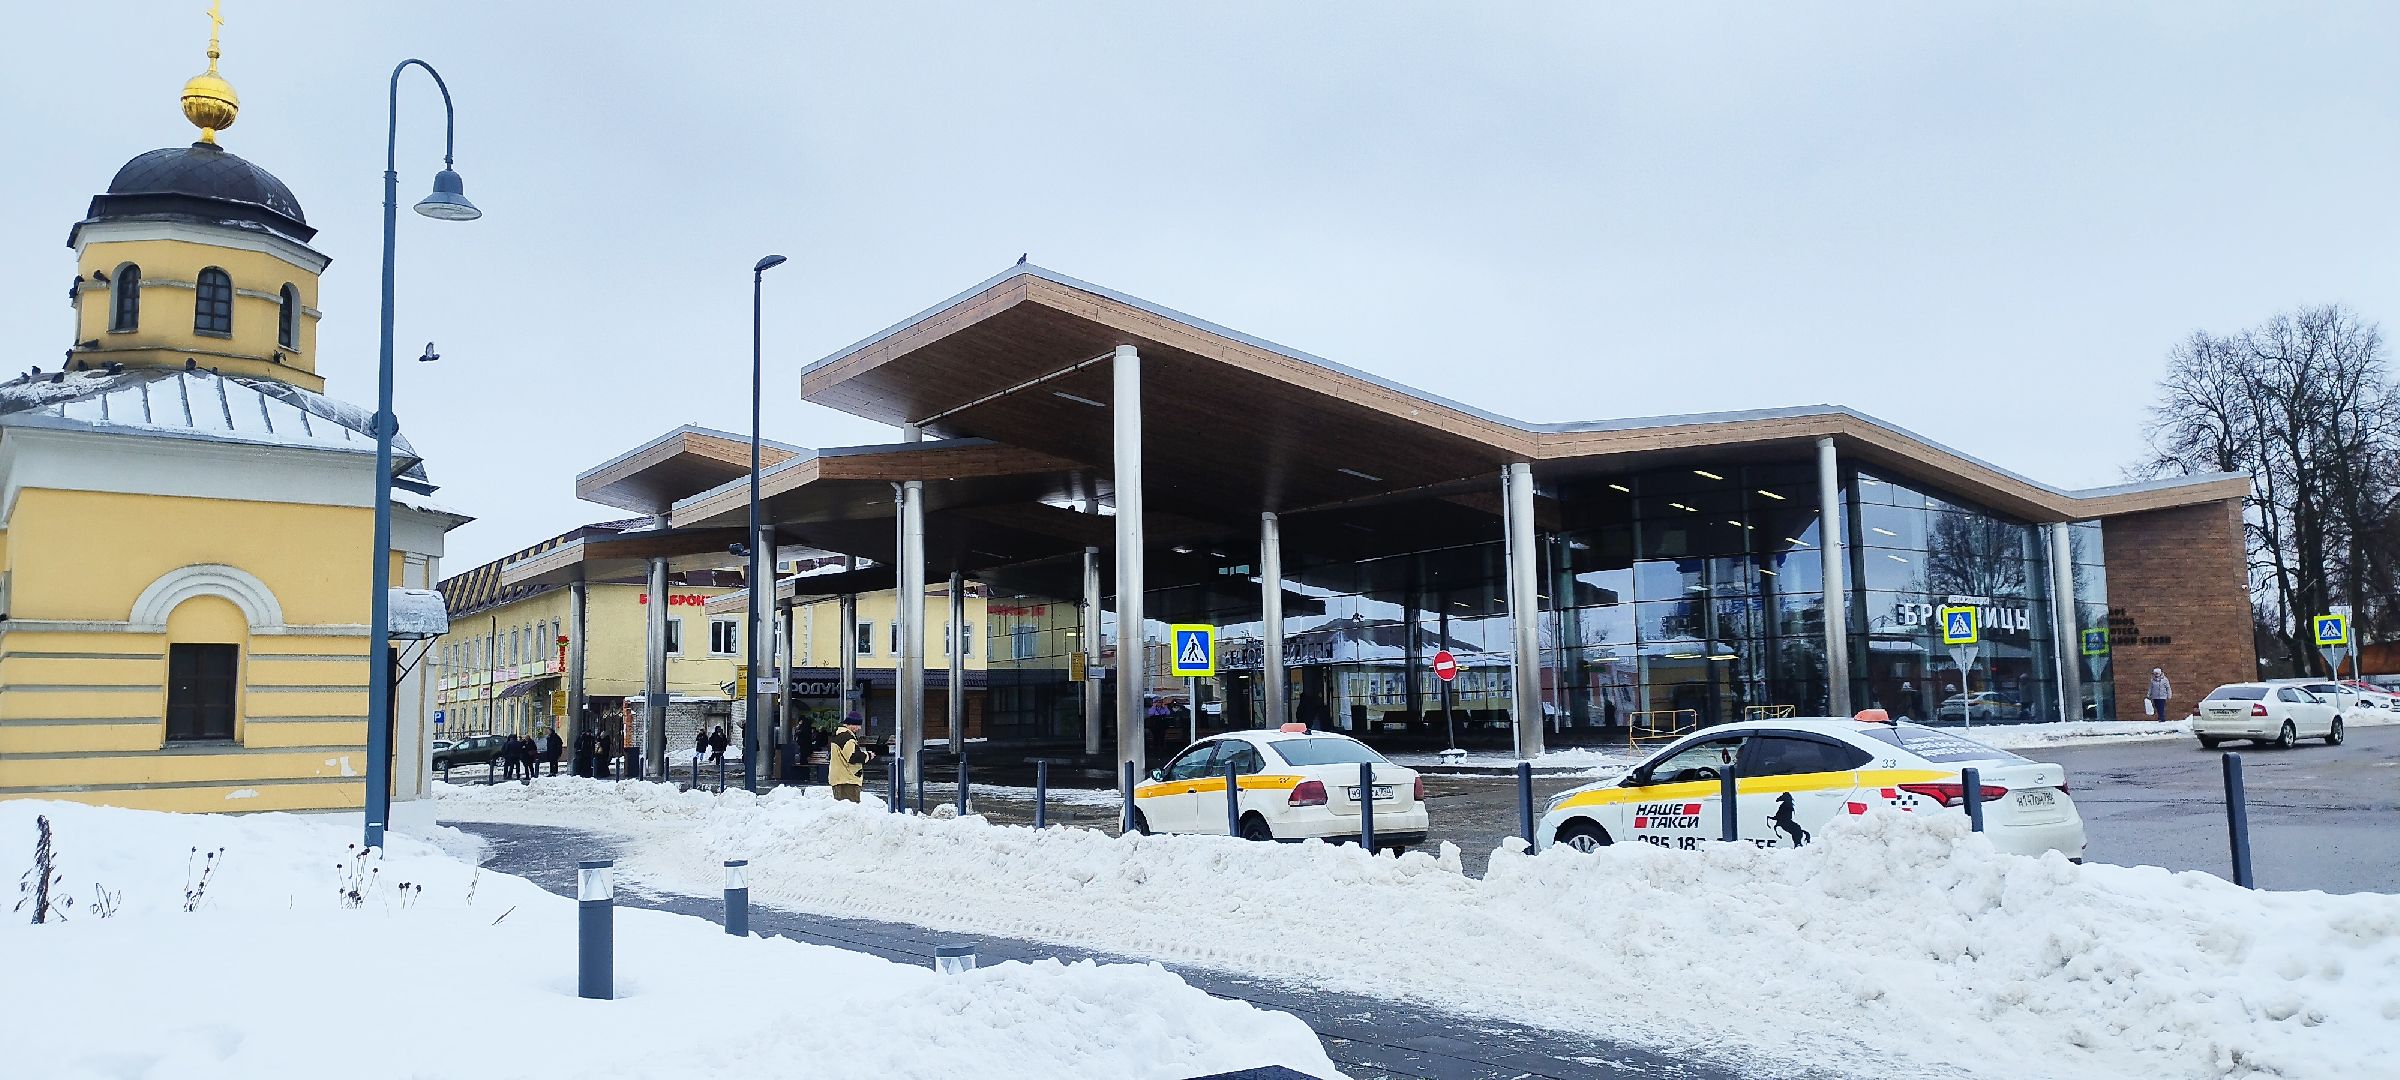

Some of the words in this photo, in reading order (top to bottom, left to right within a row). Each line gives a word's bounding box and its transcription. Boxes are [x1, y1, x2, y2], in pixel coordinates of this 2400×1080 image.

[1905, 603, 2030, 634] БРОИЦЫ
[1882, 758, 1897, 769] 33
[1636, 803, 1684, 816] НАШЕ
[1649, 816, 1700, 829] ТАКСИ
